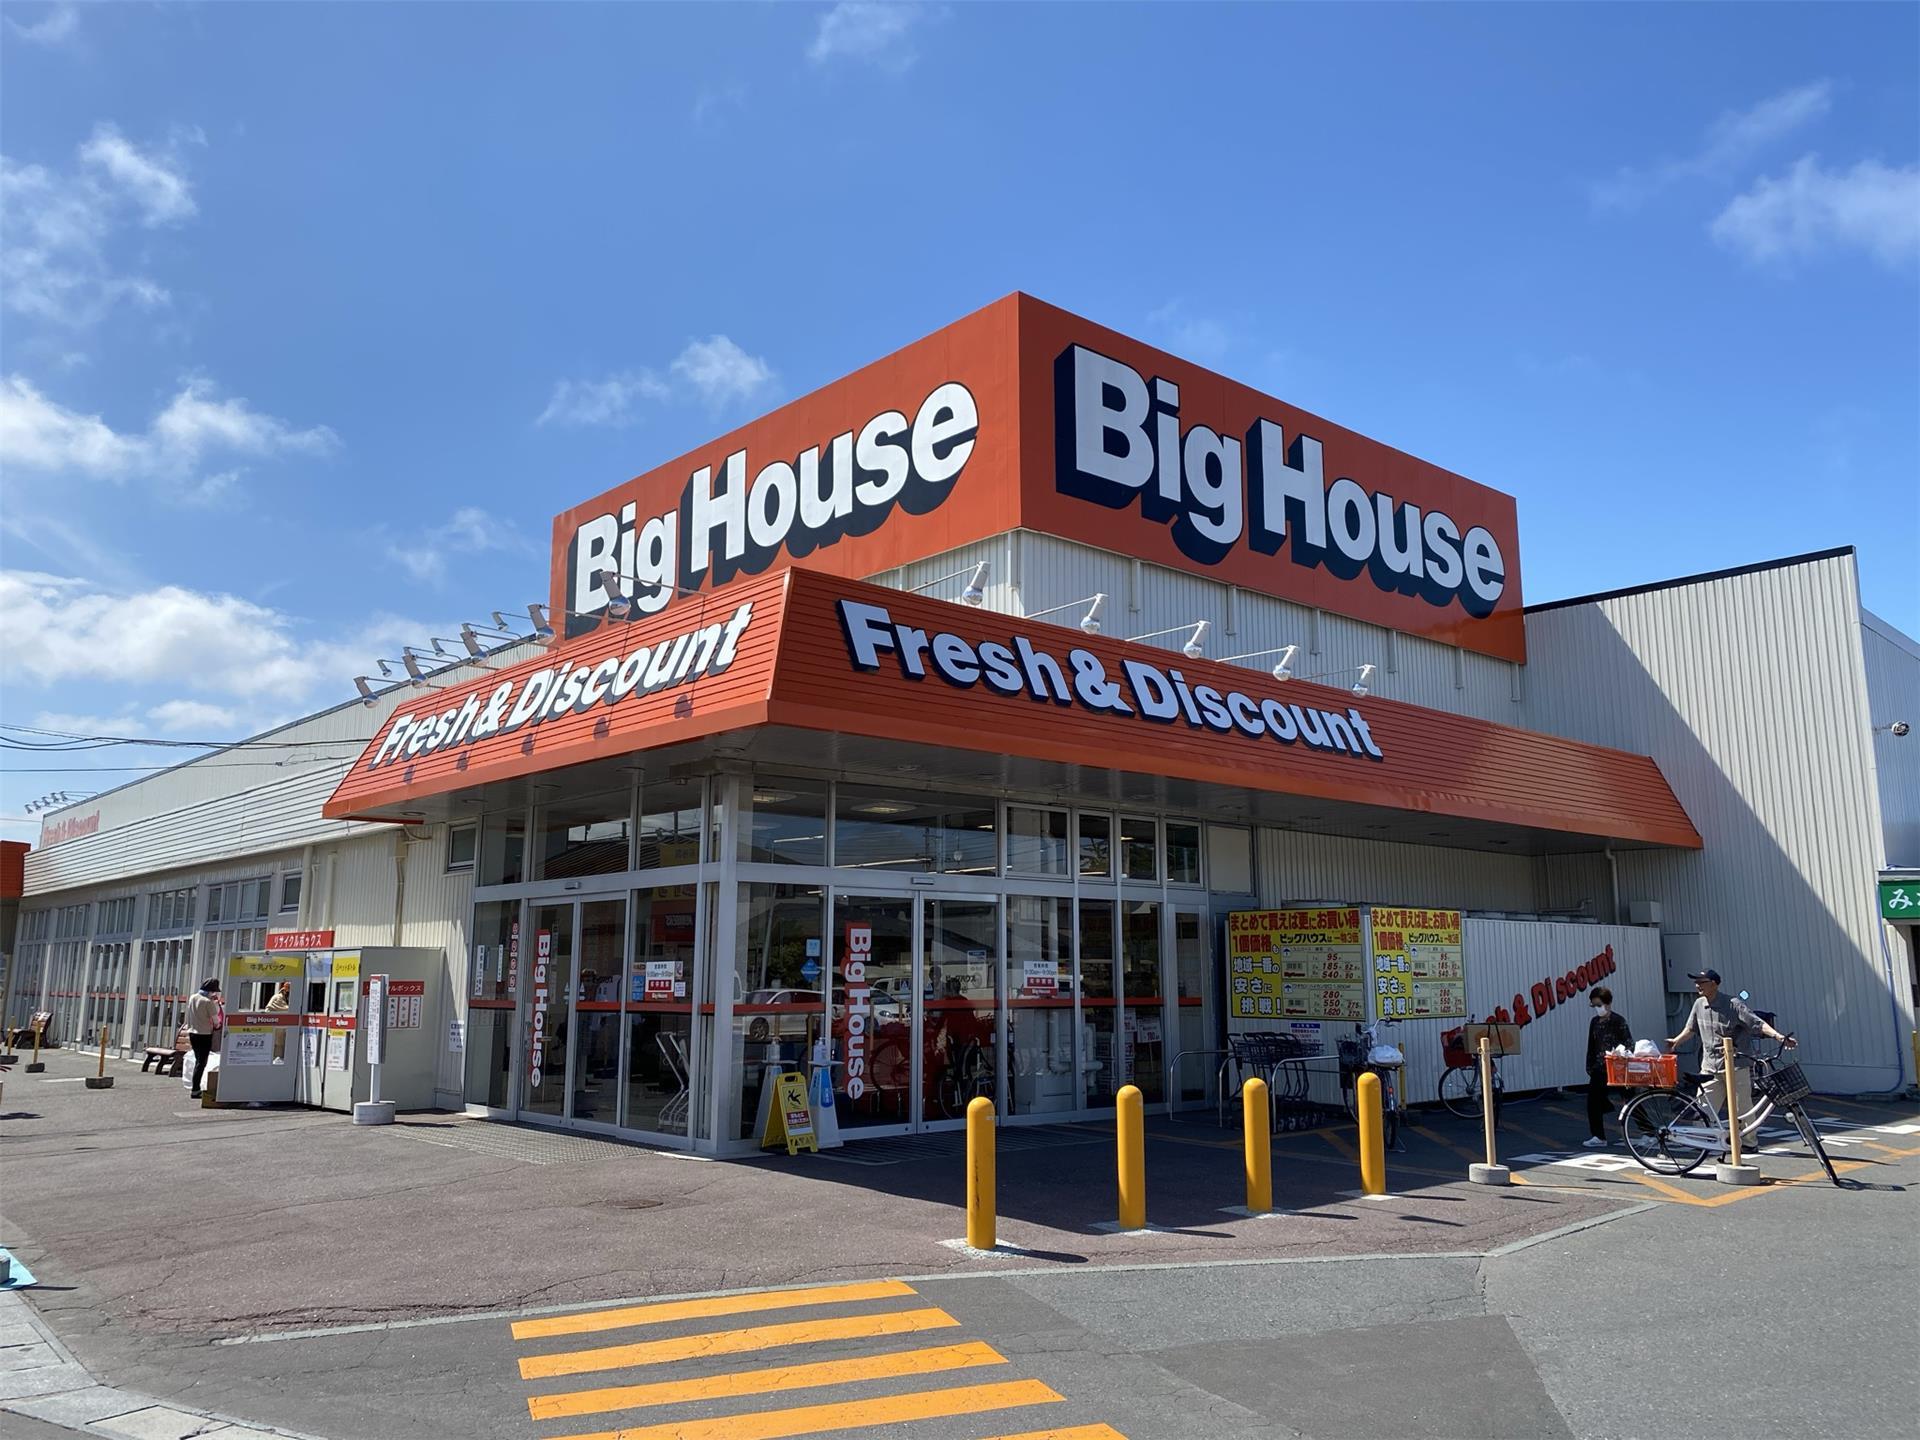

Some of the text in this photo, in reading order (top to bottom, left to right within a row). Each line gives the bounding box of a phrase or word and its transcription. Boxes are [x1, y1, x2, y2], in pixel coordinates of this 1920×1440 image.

[1073, 344, 1505, 602] Big House
[574, 381, 979, 617] Big House
[1231, 910, 1359, 931] まとめて買えば更にお買い得
[274, 934, 322, 948] リサイクルボックス
[1233, 957, 1279, 973] 地域一番の
[1234, 978, 1272, 994] 安さに
[1377, 977, 1406, 994] 安さに
[532, 934, 550, 1088] Big House
[845, 928, 871, 1099] Big House
